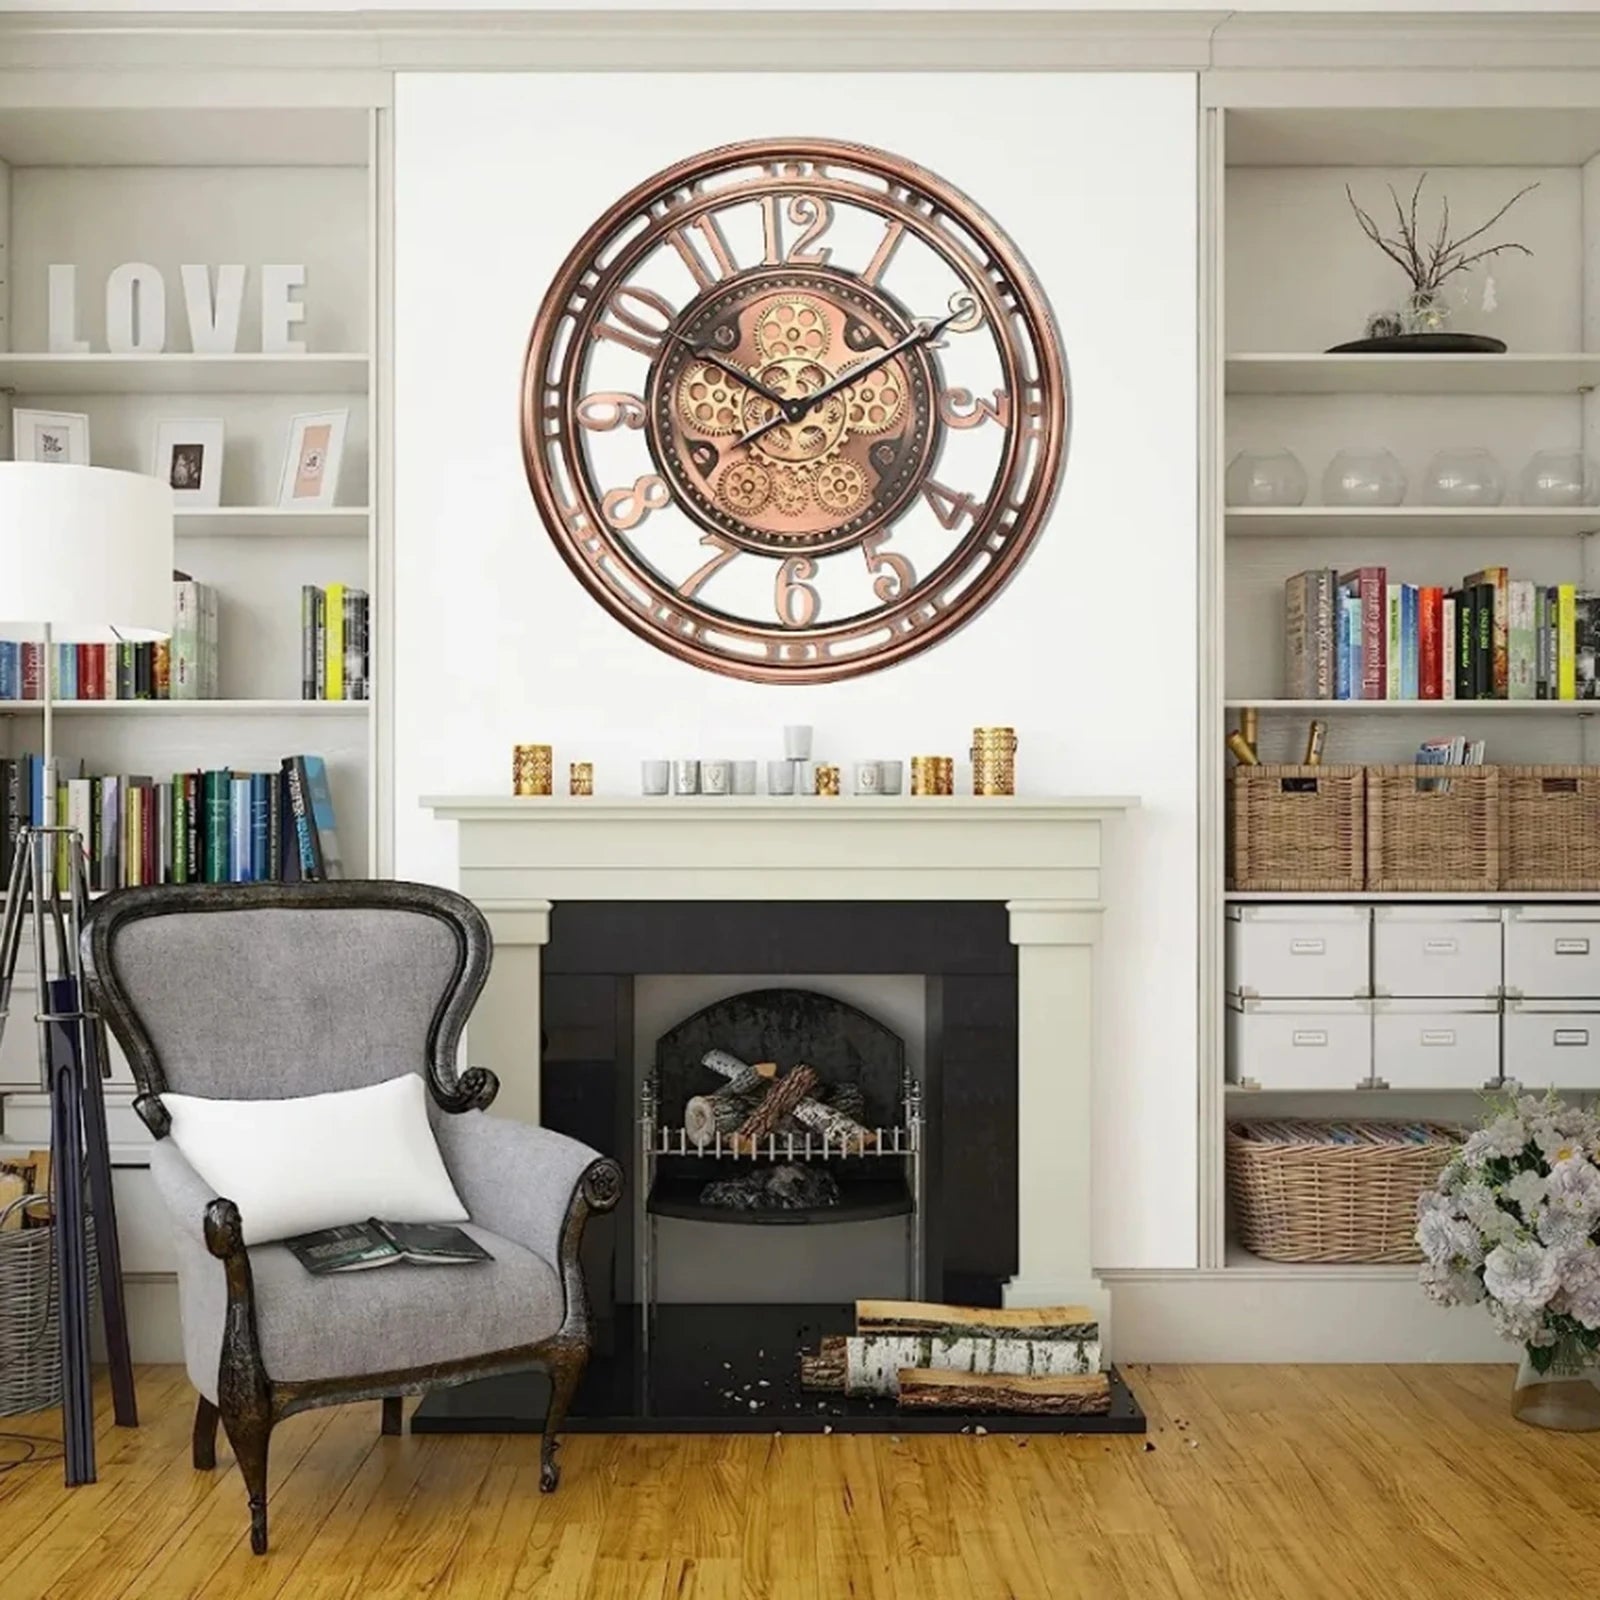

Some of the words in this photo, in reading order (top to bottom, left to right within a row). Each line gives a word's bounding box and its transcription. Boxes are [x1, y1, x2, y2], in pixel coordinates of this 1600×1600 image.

[665, 214, 738, 289] 11
[759, 195, 829, 265] 12
[860, 219, 904, 286] 1
[48, 261, 306, 353] LOVE
[591, 286, 678, 364] 10
[575, 392, 646, 431] 9
[940, 387, 1010, 429] 3
[601, 475, 670, 529] 8
[923, 478, 984, 529] 4
[679, 533, 742, 598] 7
[775, 556, 818, 627] 6
[862, 527, 914, 601] 5
